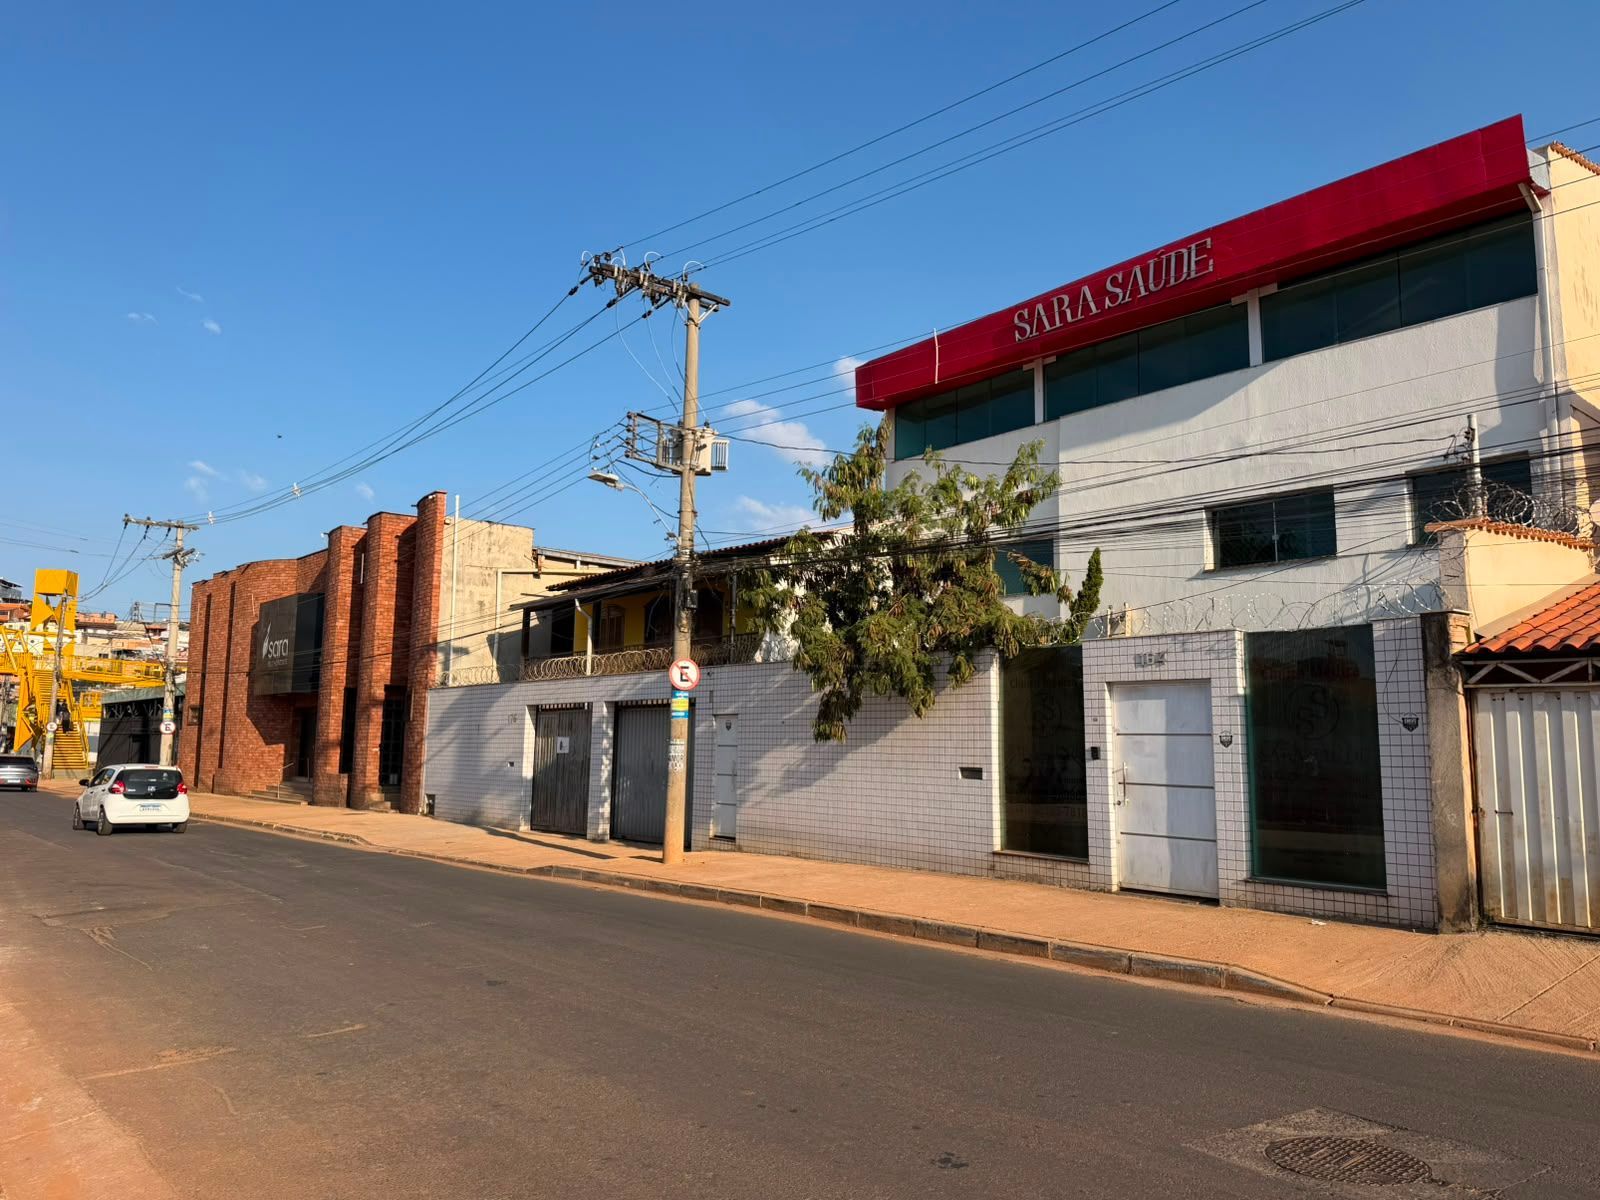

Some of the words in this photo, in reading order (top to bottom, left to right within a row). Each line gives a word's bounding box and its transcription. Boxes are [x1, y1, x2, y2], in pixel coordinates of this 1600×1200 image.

[1013, 285, 1101, 342] SARA
[1104, 237, 1214, 310] SAÚDE
[268, 639, 289, 658] sara
[680, 666, 690, 682] E
